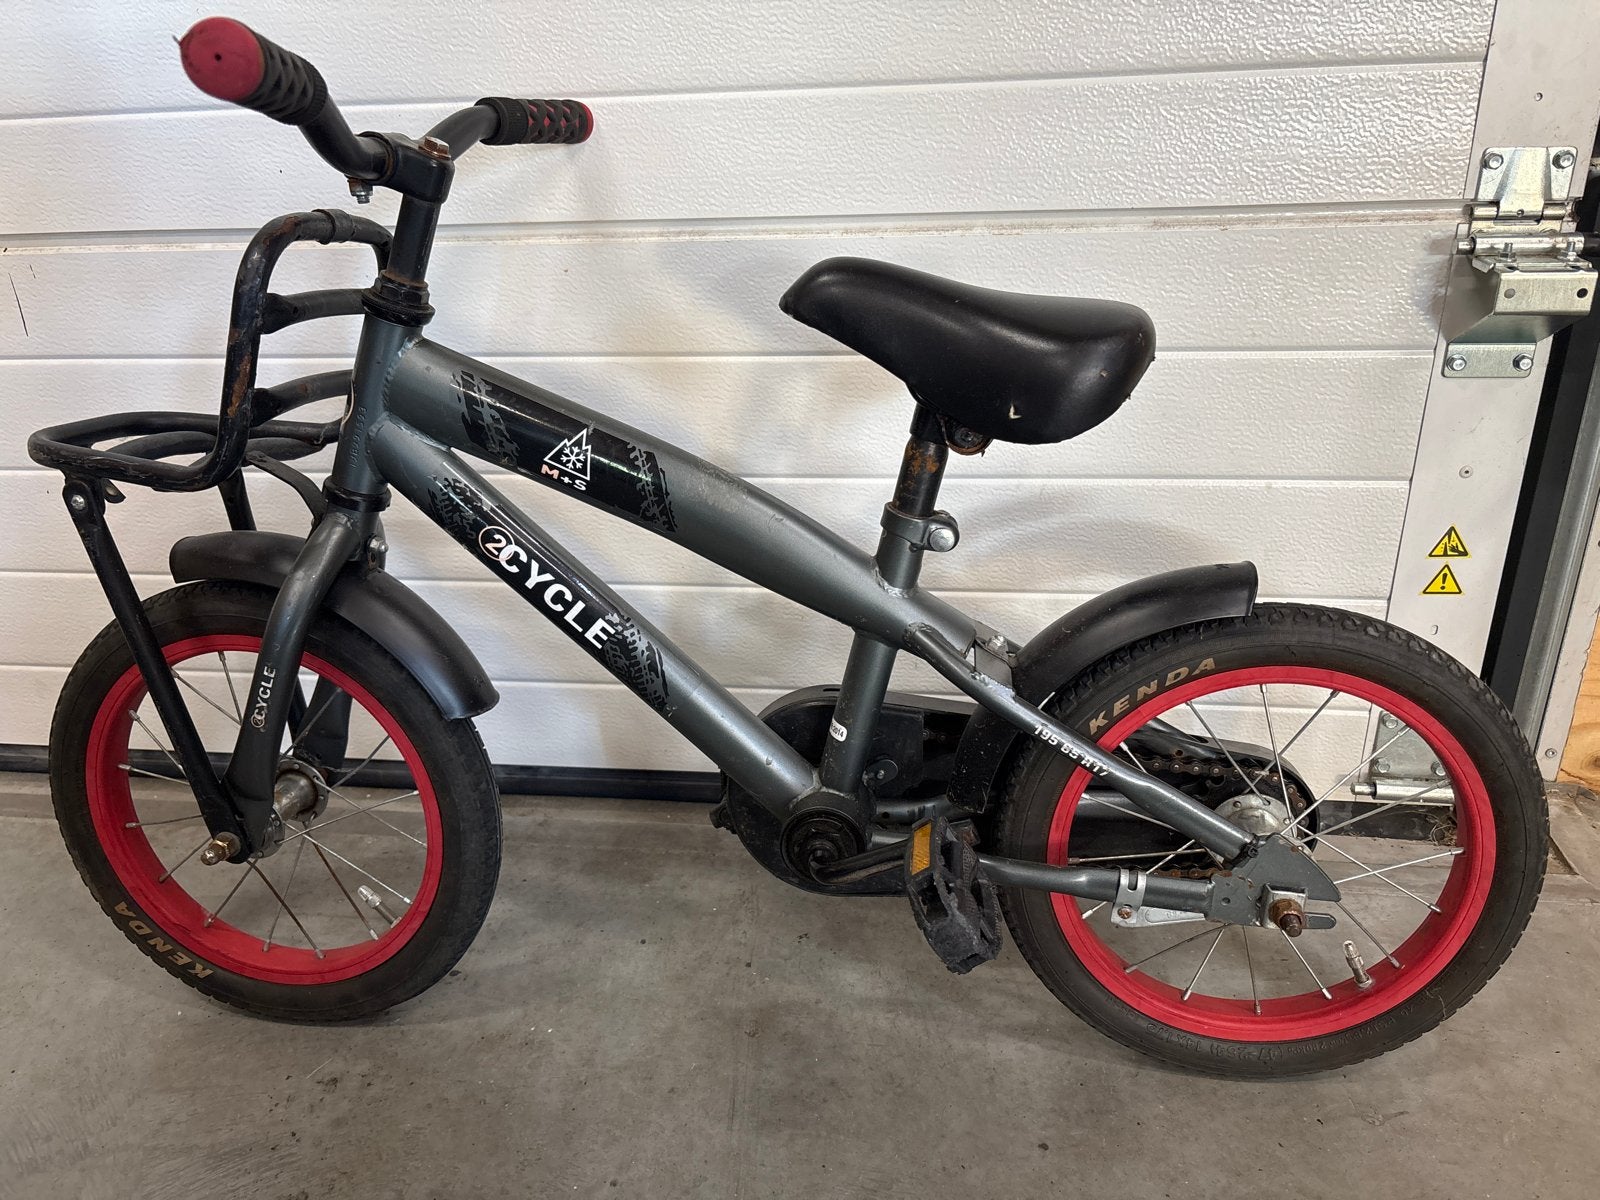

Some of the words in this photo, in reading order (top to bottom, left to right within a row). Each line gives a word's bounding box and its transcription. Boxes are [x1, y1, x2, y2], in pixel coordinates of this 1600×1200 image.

[541, 464, 587, 492] M+S
[1088, 657, 1216, 736] KENDA
[1034, 725, 1061, 746] 195
[114, 901, 214, 979] KENDA
